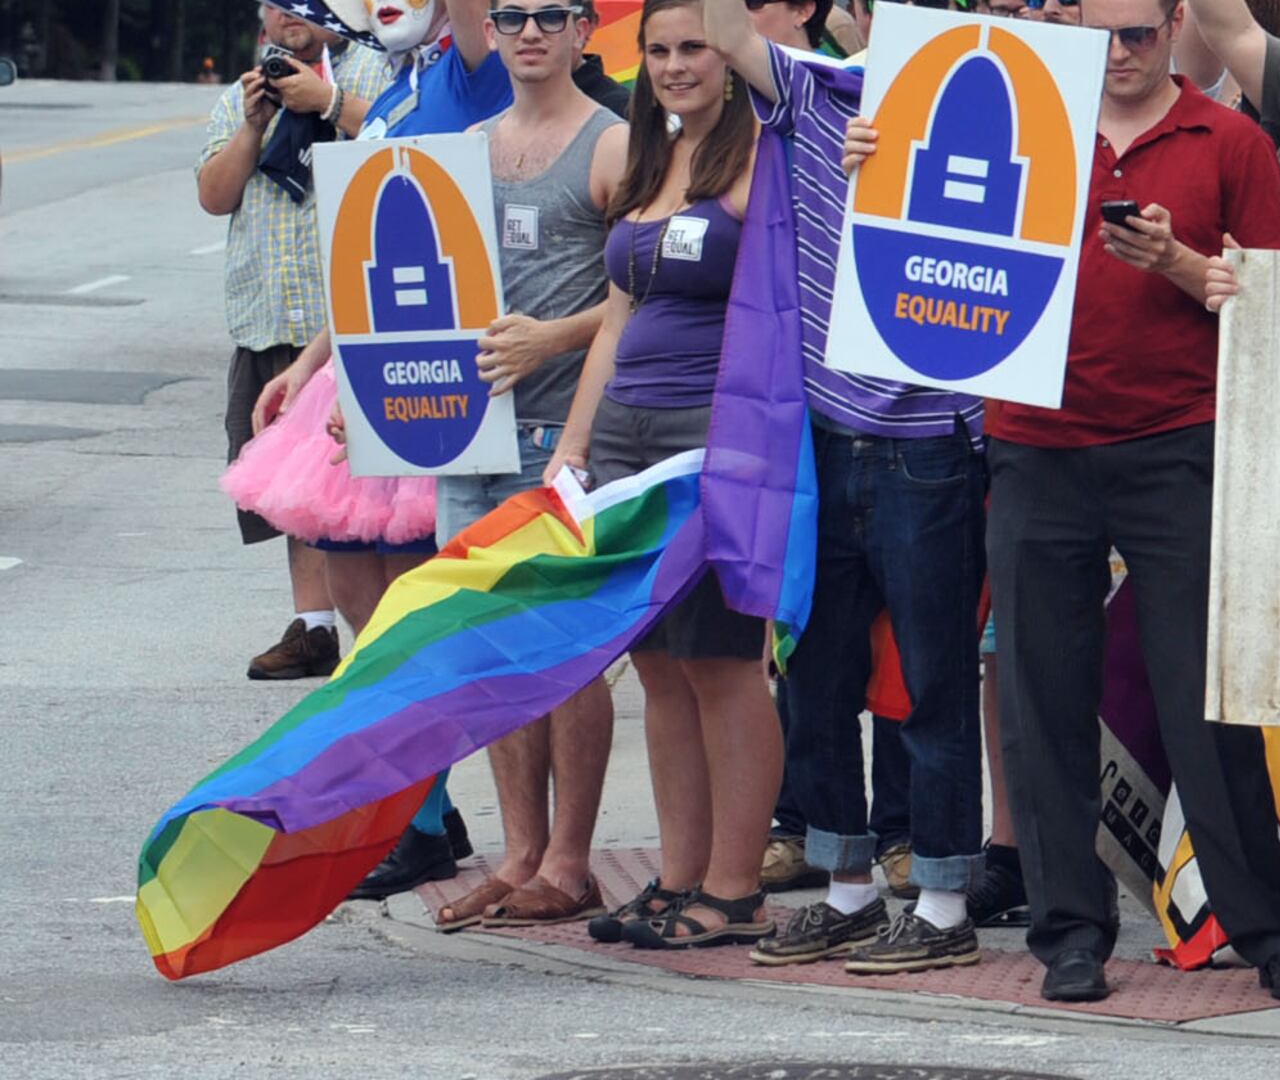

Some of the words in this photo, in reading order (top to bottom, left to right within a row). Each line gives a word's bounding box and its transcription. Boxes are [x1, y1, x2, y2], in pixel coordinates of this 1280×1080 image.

[905, 254, 1008, 297] GEORGIA
[895, 292, 1010, 336] EQUALITY
[383, 359, 463, 386] GEORGIA
[383, 393, 469, 423] EQUALITY
